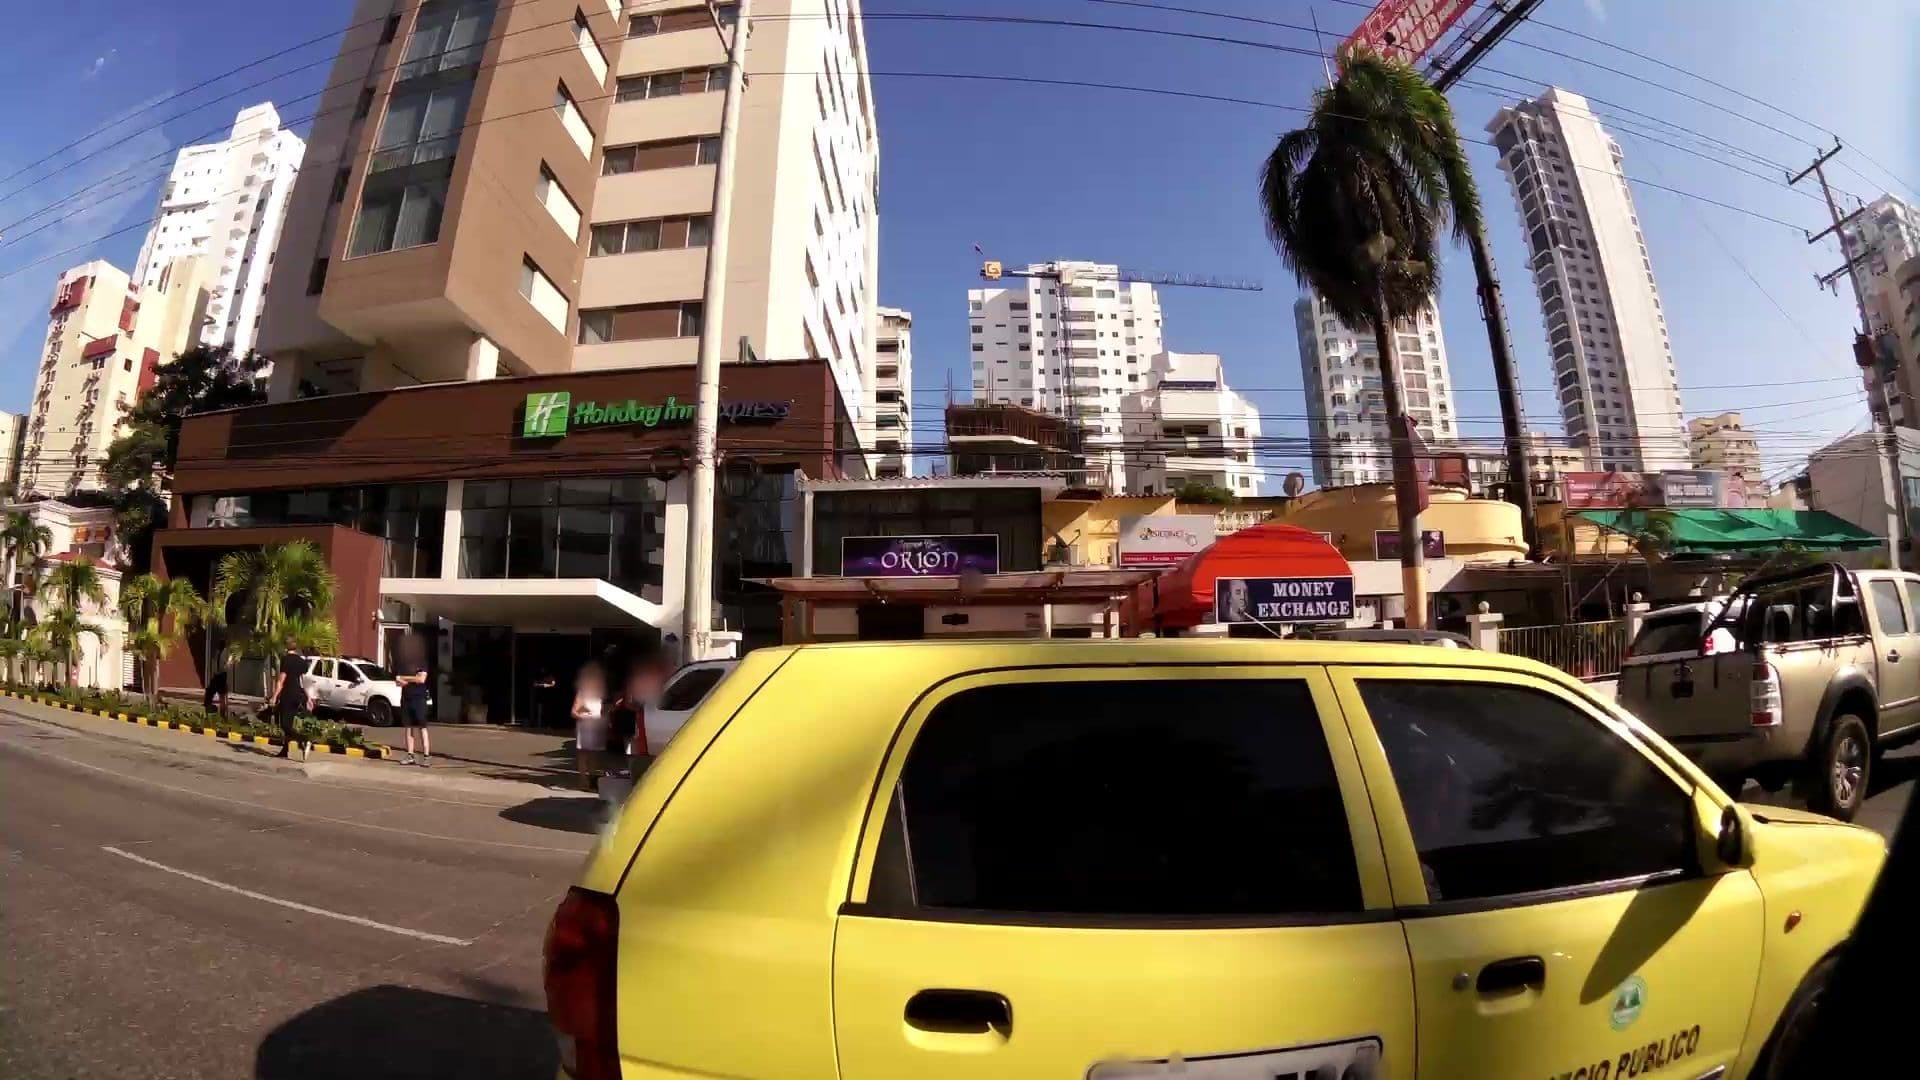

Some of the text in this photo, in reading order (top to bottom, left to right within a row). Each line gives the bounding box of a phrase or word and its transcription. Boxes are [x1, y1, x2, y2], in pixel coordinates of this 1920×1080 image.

[574, 399, 662, 427] Holiday
[1273, 582, 1335, 597] MONEY
[1257, 601, 1350, 617] EXCHANGE
[1614, 1025, 1700, 1080] PUBLICO
